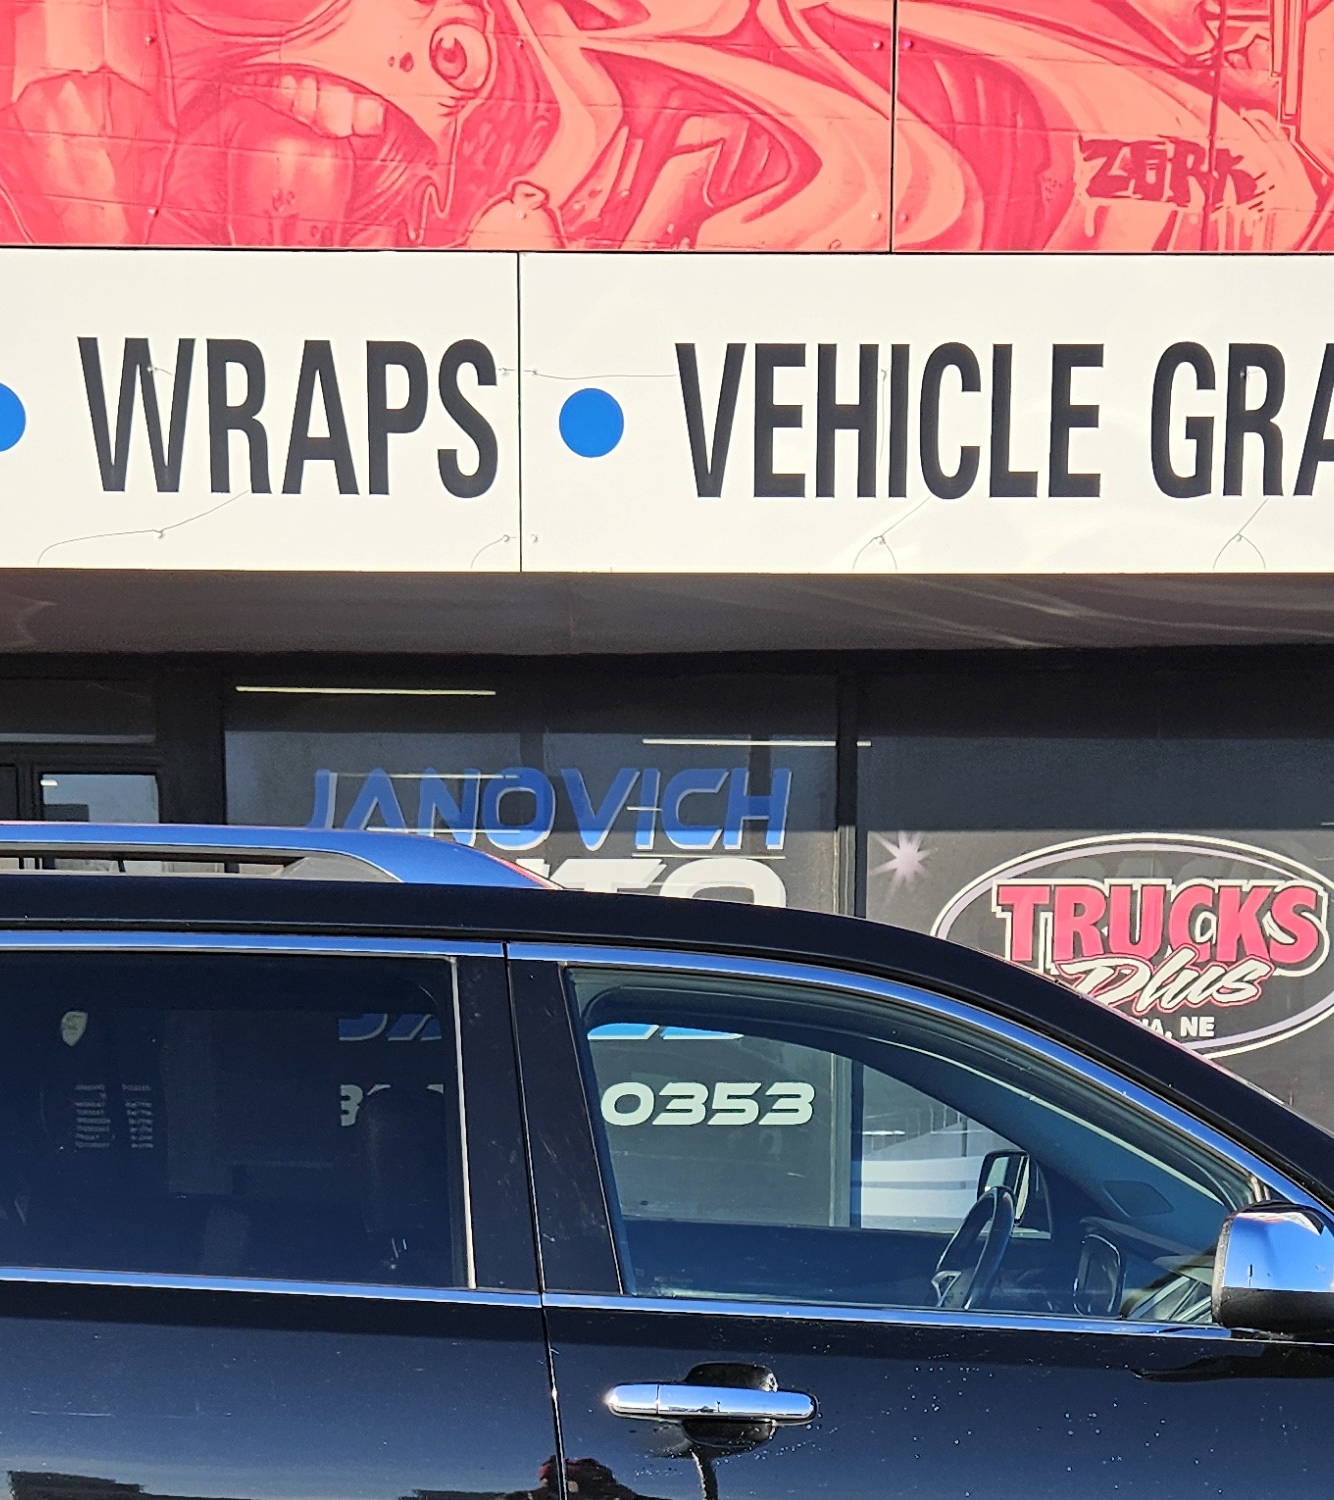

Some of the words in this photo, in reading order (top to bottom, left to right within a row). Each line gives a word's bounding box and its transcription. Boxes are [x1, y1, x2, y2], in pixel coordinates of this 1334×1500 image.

[77, 336, 499, 499] WRAPS
[675, 340, 1105, 499] VEHICLE
[309, 767, 793, 851] JANOVICH
[994, 880, 1325, 972] TRUCKS
[1056, 944, 1275, 1014] Plus
[1180, 1016, 1215, 1037] NE
[600, 1081, 816, 1127] 0353
